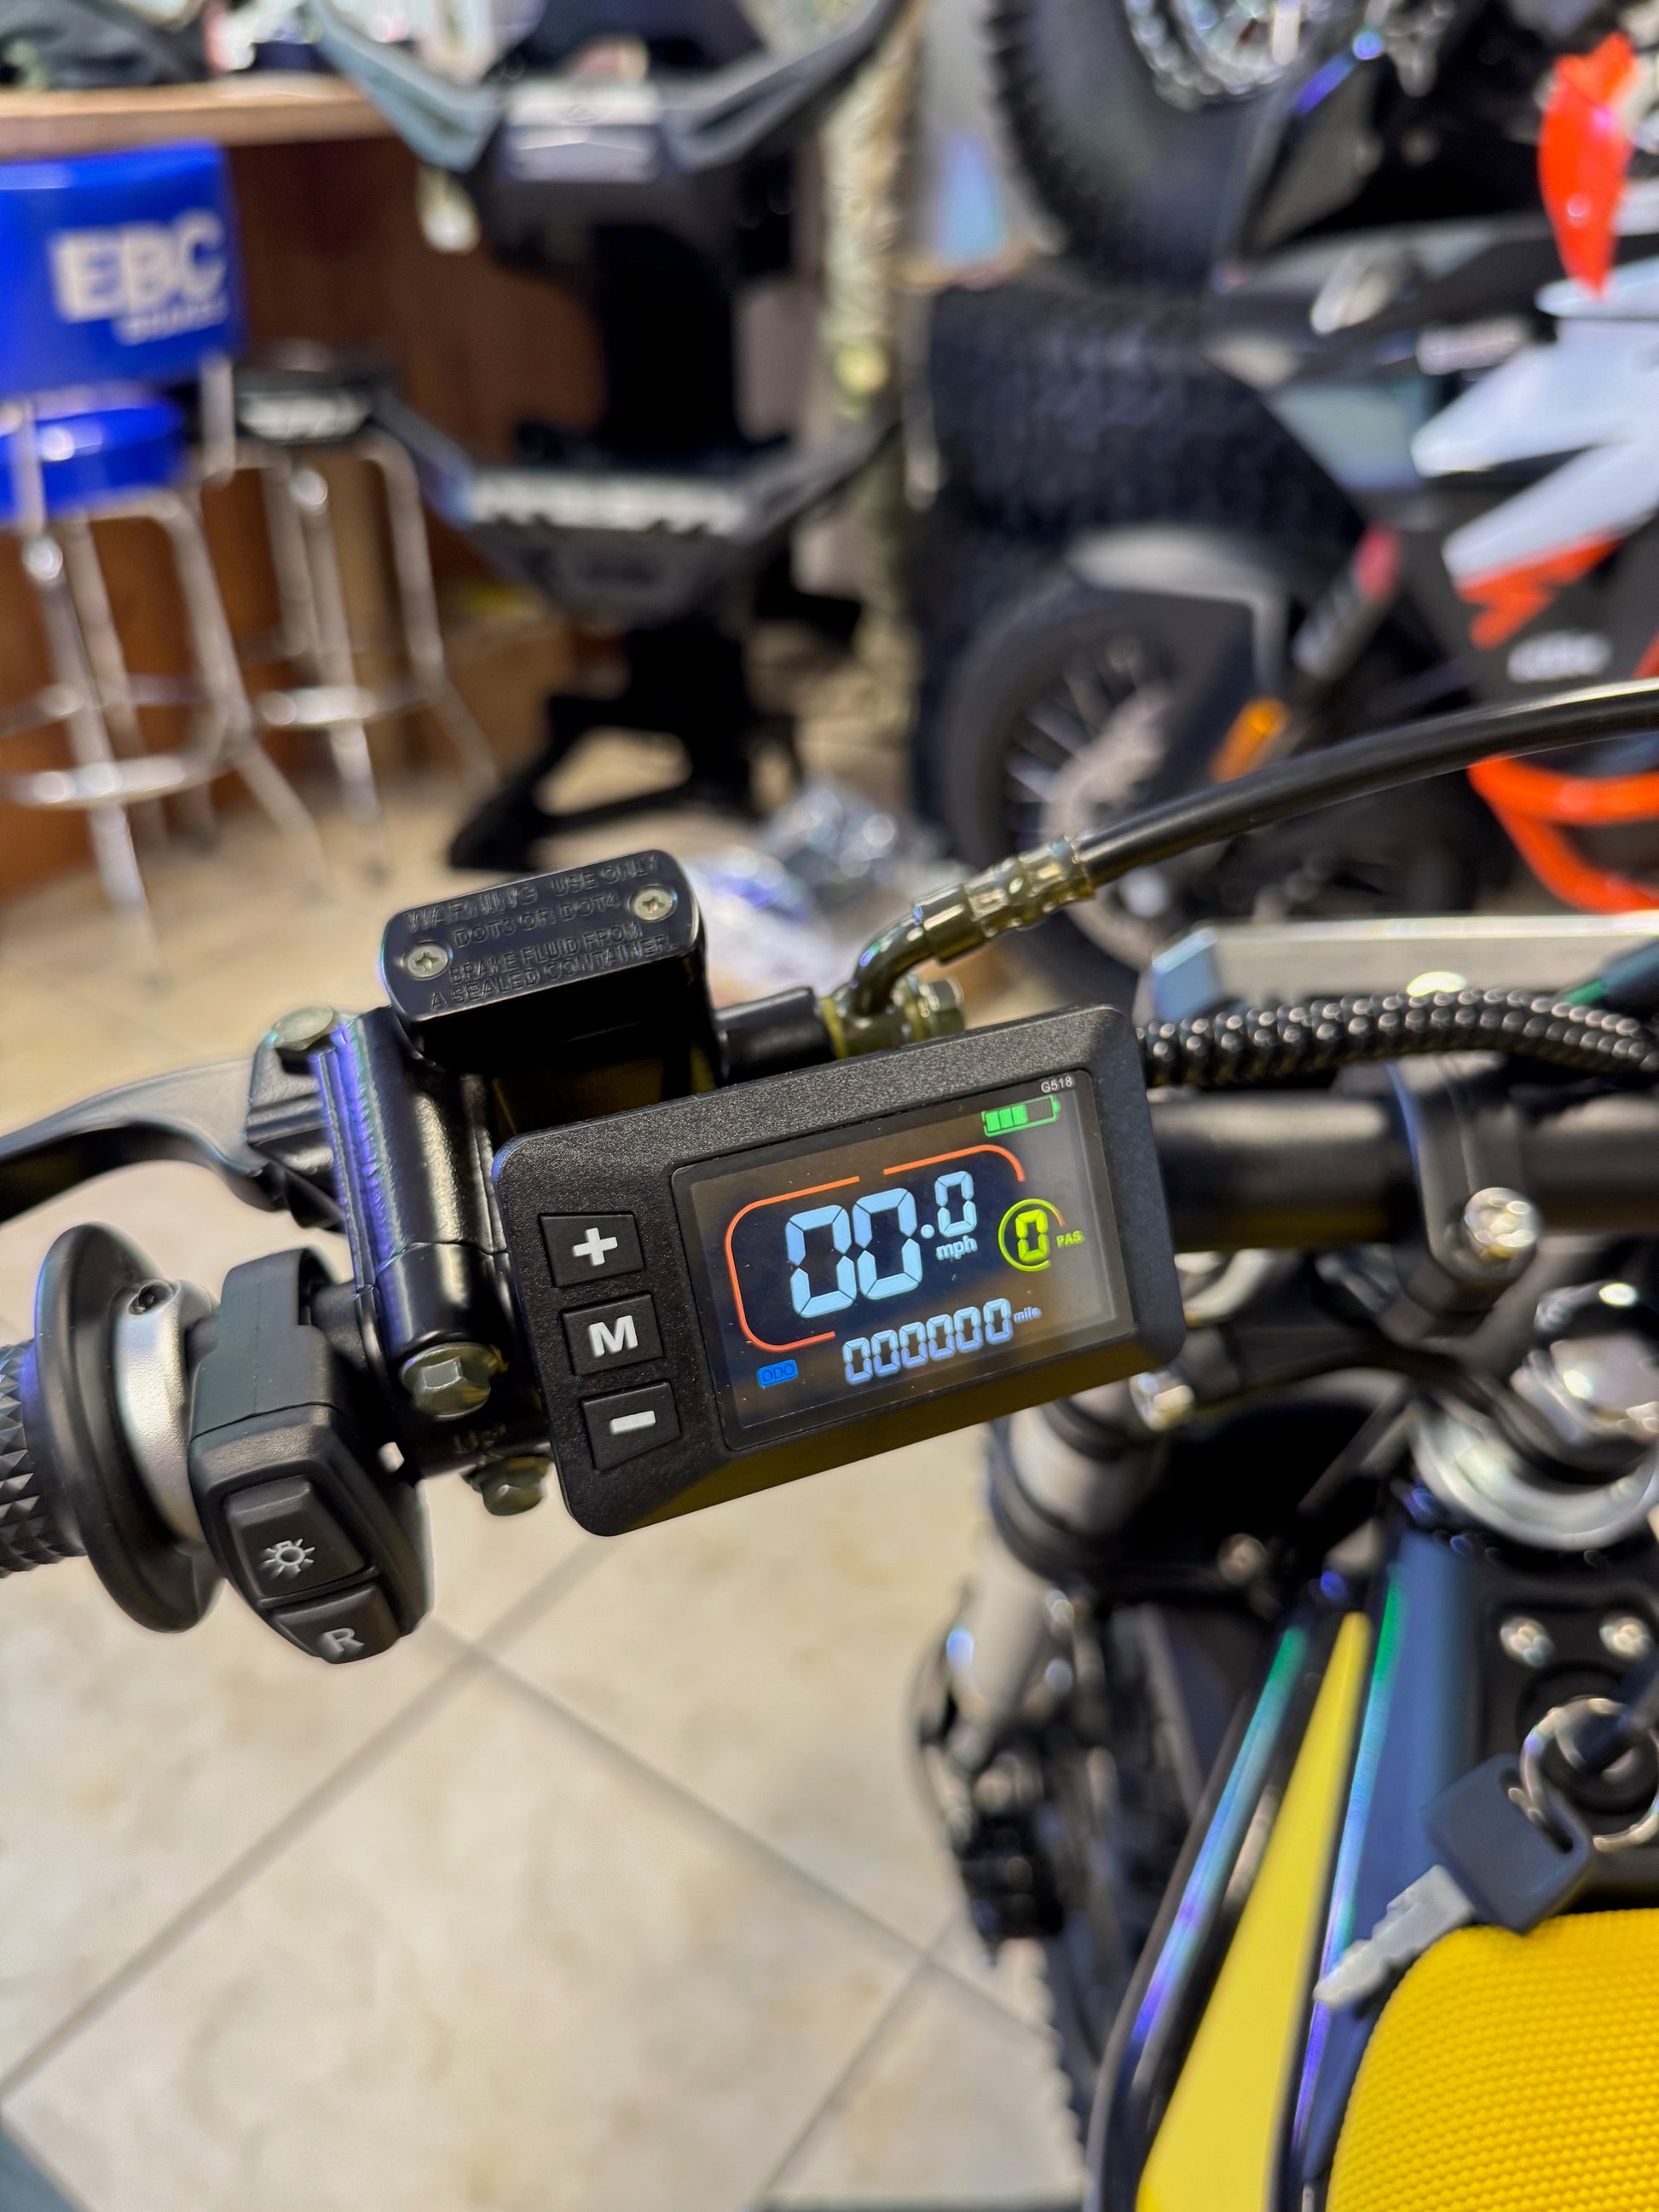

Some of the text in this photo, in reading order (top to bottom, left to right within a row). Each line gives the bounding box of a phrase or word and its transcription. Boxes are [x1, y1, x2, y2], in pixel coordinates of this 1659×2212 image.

[49, 209, 230, 323] EBC
[408, 855, 659, 933] WARNING USE ONLY
[454, 892, 620, 948] DOT3 OR DOT4
[449, 921, 644, 984] BRAKE FLUID FROM
[430, 991, 448, 1011] A
[450, 967, 541, 1004] SEALED
[1040, 1076, 1072, 1094] G518
[935, 1235, 978, 1262] mph
[1014, 1209, 1084, 1263] 0 PAS
[587, 1314, 639, 1359] M
[841, 1297, 1042, 1386] 000000 mile
[760, 1361, 796, 1385] ODO
[321, 1626, 365, 1659] R
